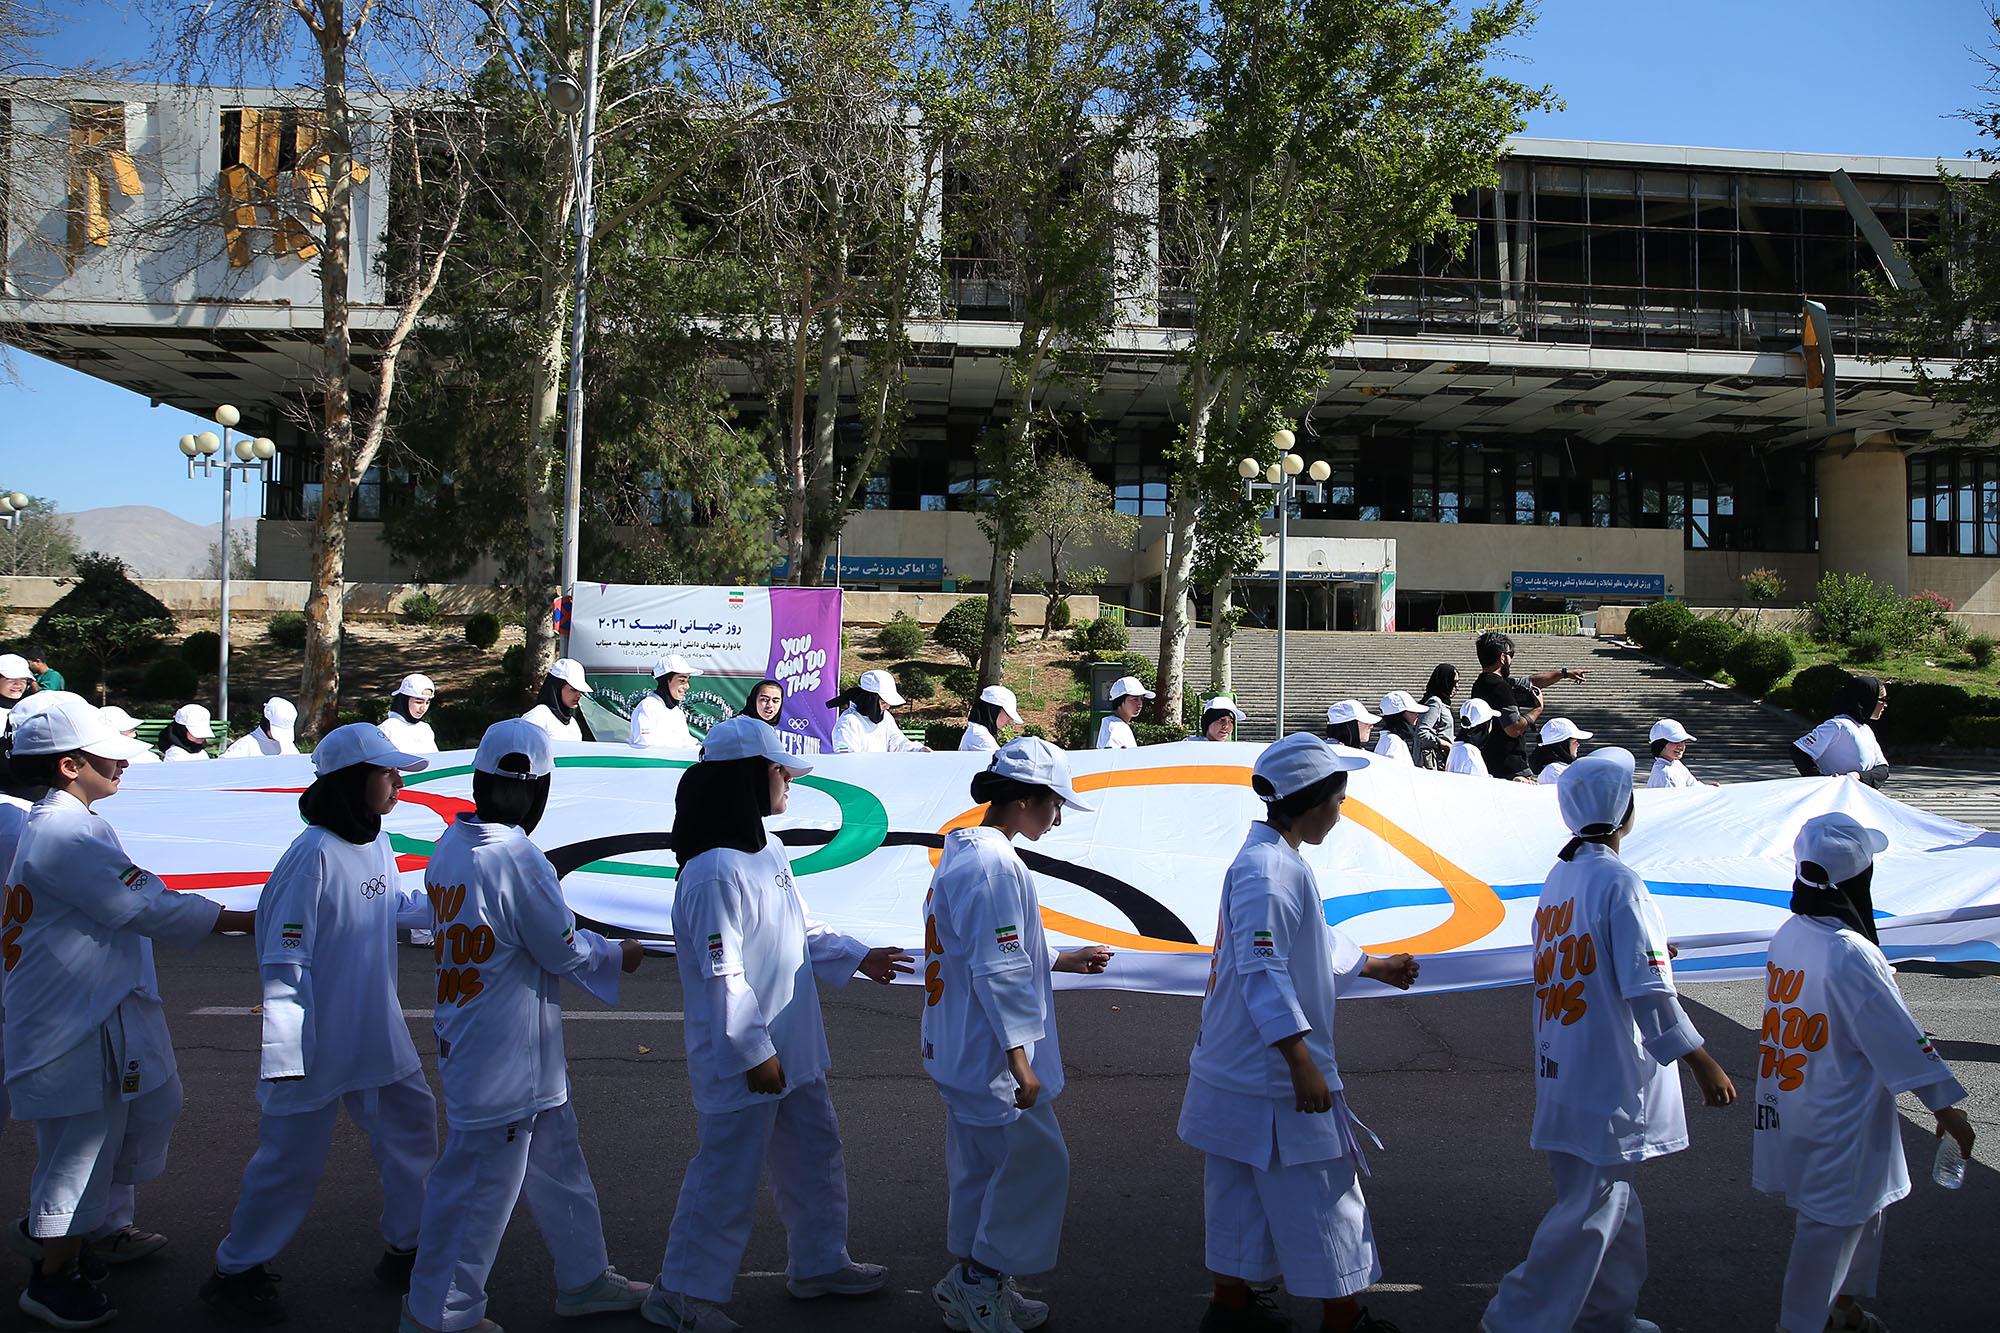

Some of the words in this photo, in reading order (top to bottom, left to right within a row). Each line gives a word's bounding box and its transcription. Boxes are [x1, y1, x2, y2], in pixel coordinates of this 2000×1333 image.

[862, 562, 896, 575] ورزشی
[897, 563, 925, 575] اماکن
[629, 618, 677, 634] المپیک
[679, 619, 723, 634] جهانی
[725, 621, 742, 635] روز
[595, 639, 612, 649] میناب
[618, 639, 631, 648] طیبه
[649, 641, 668, 649] مدرسه
[669, 638, 682, 649] آموز
[683, 640, 700, 649] دانش
[700, 641, 721, 650] شهدای
[722, 641, 742, 651] یادواره
[780, 633, 812, 661] YOU
[775, 653, 804, 681] CAN
[805, 648, 827, 672] DO
[786, 669, 822, 698] THIS
[1535, 896, 1575, 952] YOU
[445, 923, 496, 966] DO
[1534, 940, 1558, 986] AN
[1558, 932, 1597, 981] DO
[1536, 980, 1587, 1032] THIS
[1781, 1006, 1829, 1052] DO
